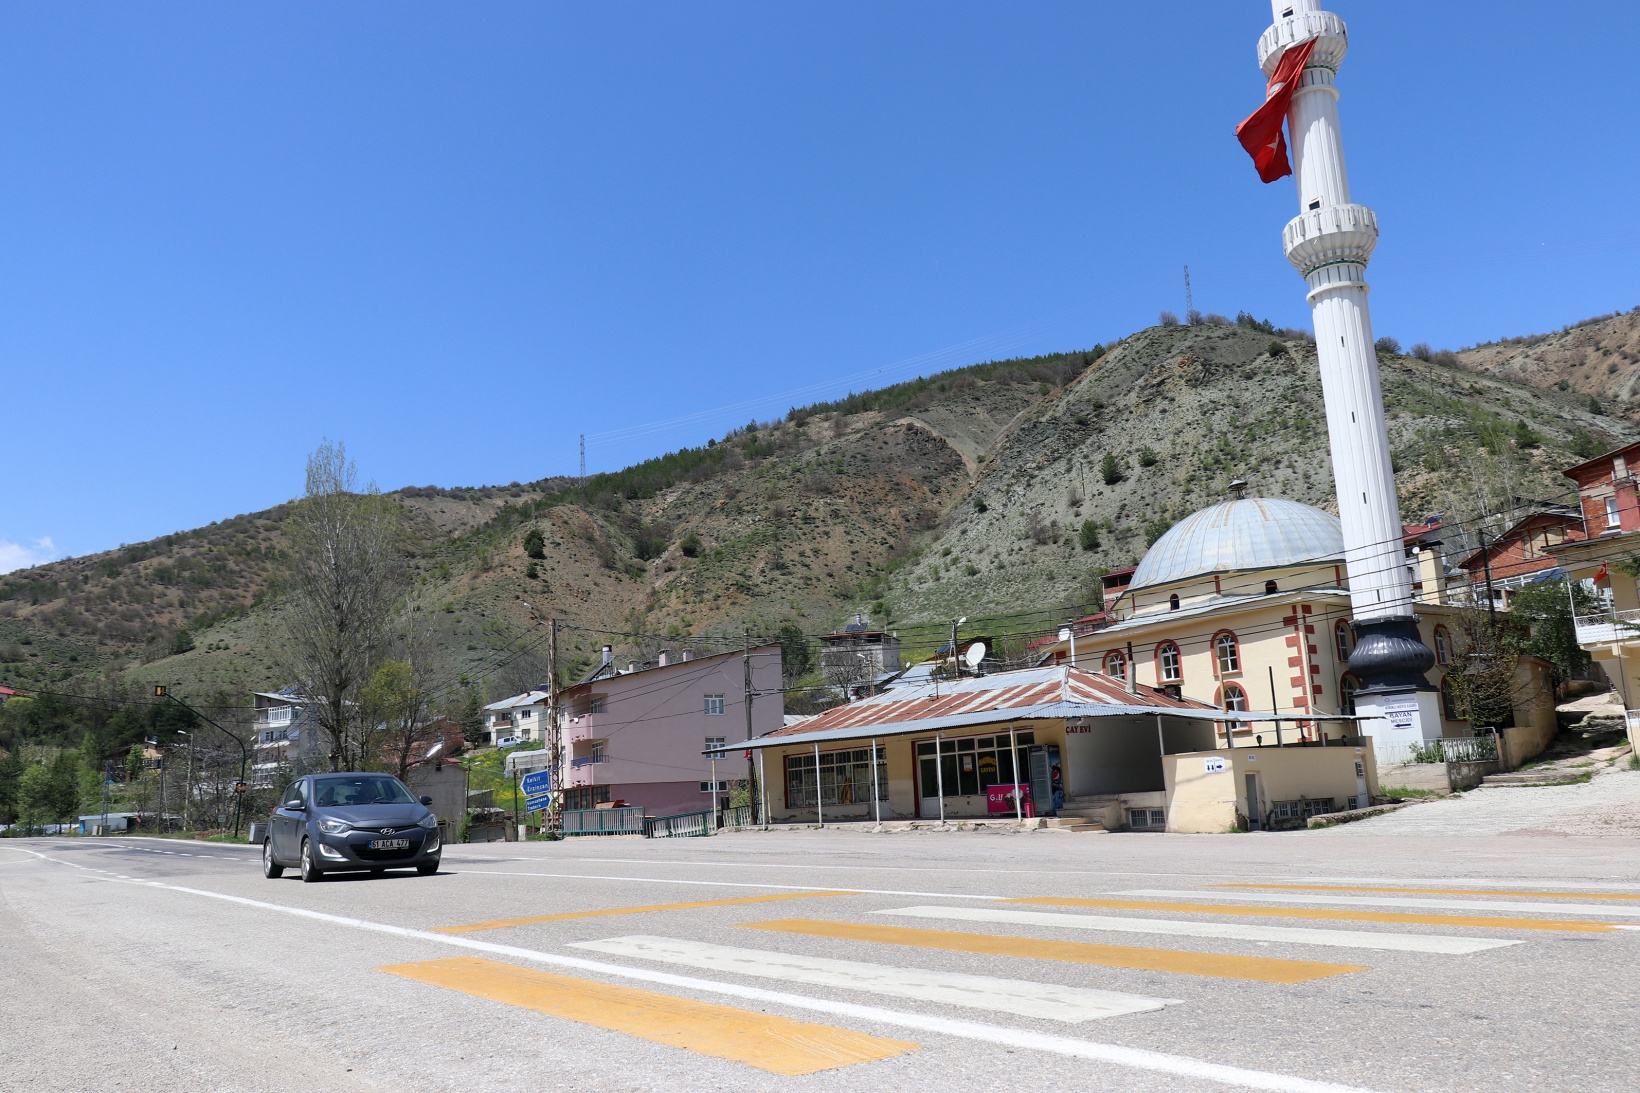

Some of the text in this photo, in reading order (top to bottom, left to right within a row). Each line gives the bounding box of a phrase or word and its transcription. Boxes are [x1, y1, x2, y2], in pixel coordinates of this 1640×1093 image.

[1065, 724, 1091, 735] ÇAY EVİ
[397, 839, 409, 847] 477
